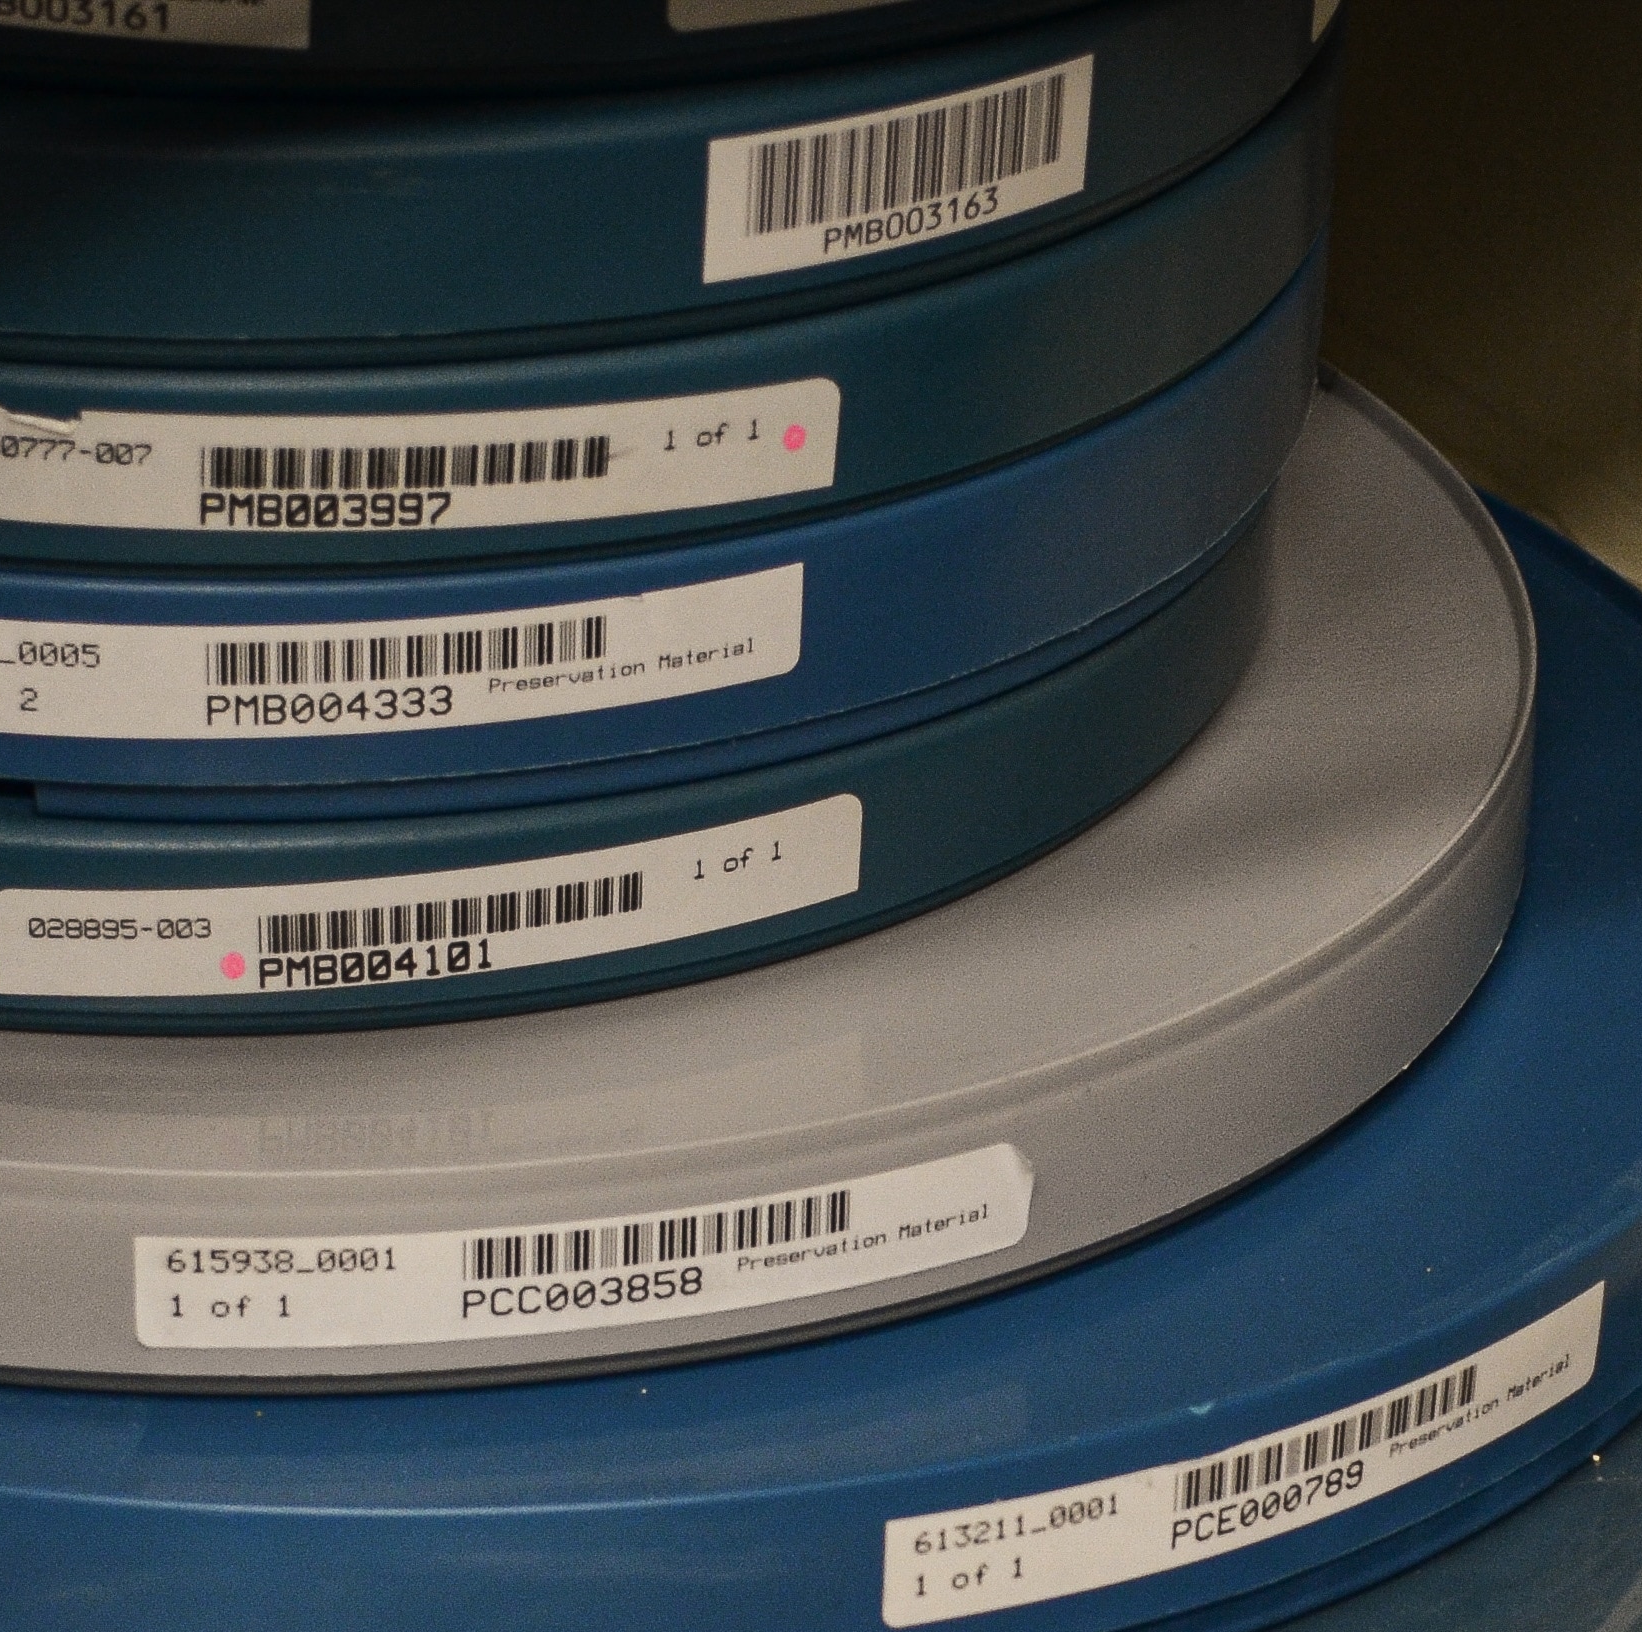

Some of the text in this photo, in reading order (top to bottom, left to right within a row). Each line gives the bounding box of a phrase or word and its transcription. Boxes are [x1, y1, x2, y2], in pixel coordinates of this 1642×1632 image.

[824, 186, 998, 254] PMB003163
[664, 420, 759, 450] 1 of 1
[201, 492, 452, 528] PMB003997
[488, 637, 755, 694] Preservation Material
[20, 688, 38, 712] 2
[207, 685, 454, 725] PMB004333
[693, 841, 782, 879] 1 of 1
[28, 917, 212, 940] 028895-003
[258, 938, 492, 988] PMB004101
[737, 1203, 990, 1271] Preservation Material
[166, 1248, 397, 1274] 615938_0001
[171, 1295, 291, 1318] 1 of 1
[462, 1266, 704, 1319] PCC003858
[1388, 1353, 1571, 1458] Preservation Material
[914, 1494, 1119, 1555] 613211_0001
[1172, 1460, 1364, 1550] PCE000789
[916, 1557, 1023, 1597] 1 of 1
